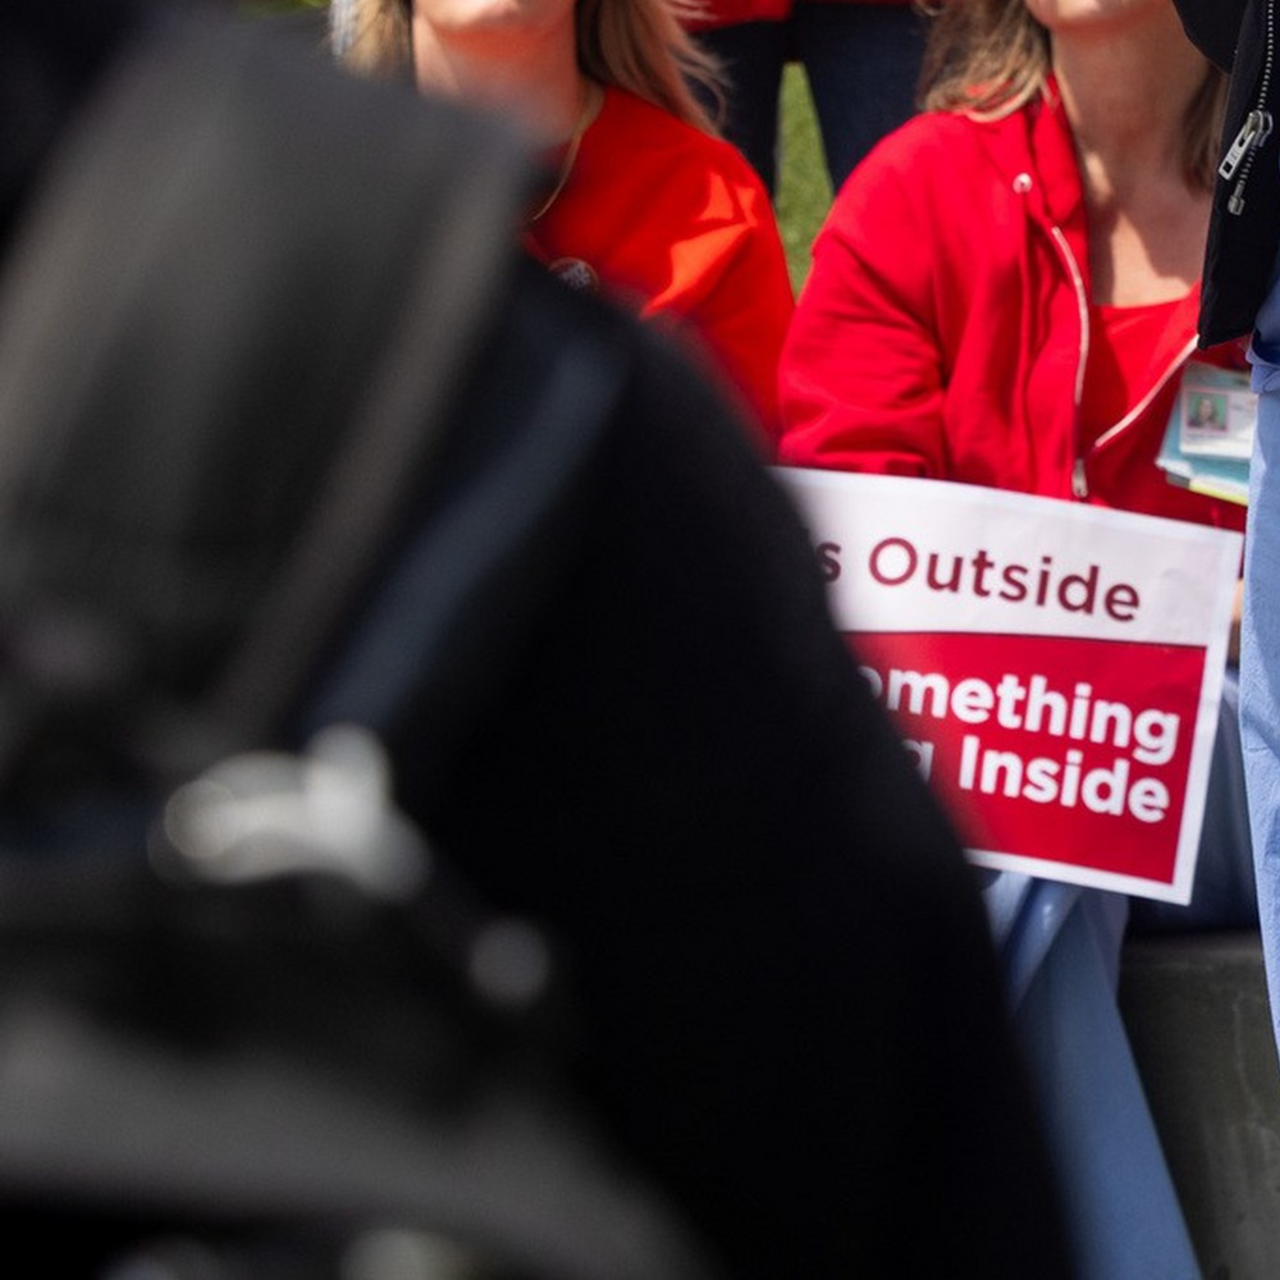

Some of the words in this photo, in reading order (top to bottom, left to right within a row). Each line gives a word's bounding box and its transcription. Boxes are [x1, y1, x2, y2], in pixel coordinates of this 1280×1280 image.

[868, 537, 1141, 622] Outside
[858, 666, 1180, 765] mething
[958, 735, 1171, 824] Inside
